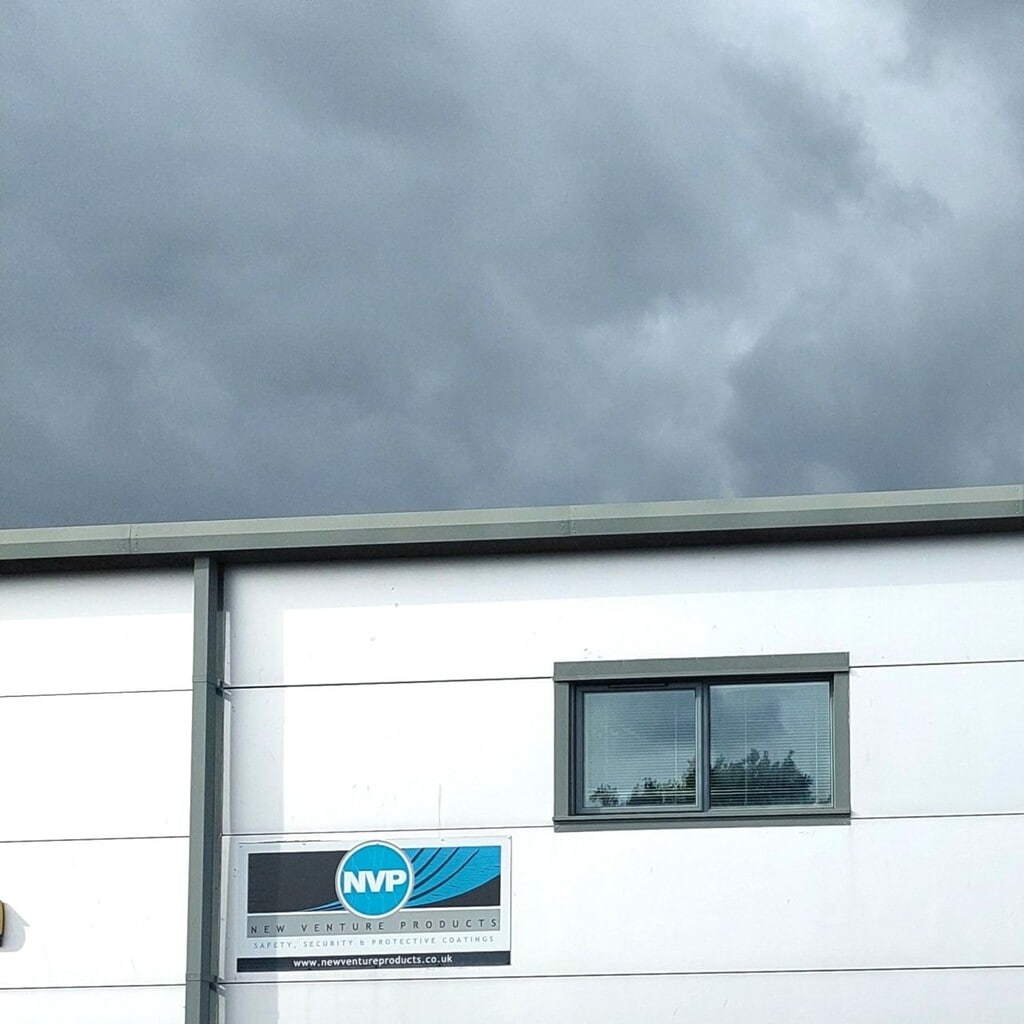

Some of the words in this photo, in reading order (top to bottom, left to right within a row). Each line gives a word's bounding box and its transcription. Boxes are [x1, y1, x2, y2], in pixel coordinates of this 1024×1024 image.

[343, 869, 407, 893] NVP
[250, 925, 286, 934] NEW
[300, 922, 385, 933] VENTURE
[400, 918, 498, 930] PRODUCTS
[303, 939, 353, 948] SECURITY
[371, 937, 436, 946] PROTECTIVE
[442, 935, 495, 944] COATINGS
[292, 954, 454, 967] www.newventureproducts.co.uk
